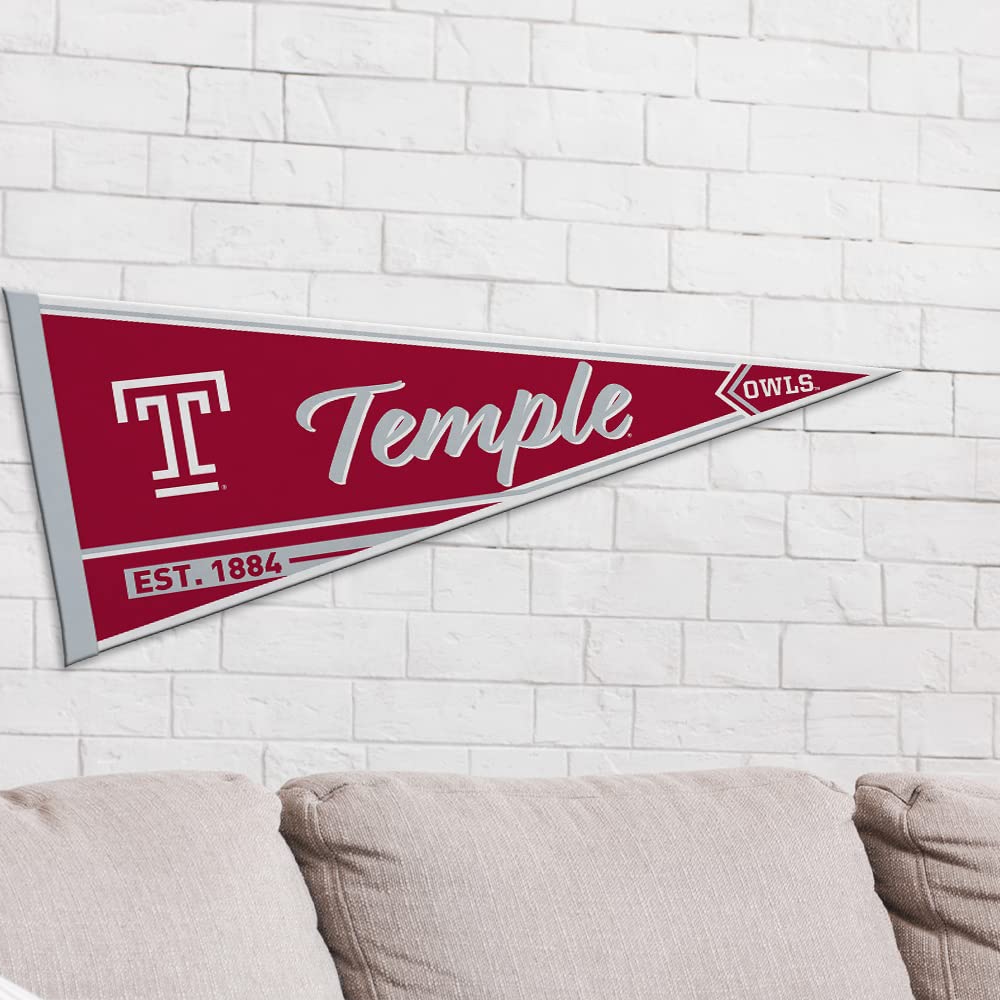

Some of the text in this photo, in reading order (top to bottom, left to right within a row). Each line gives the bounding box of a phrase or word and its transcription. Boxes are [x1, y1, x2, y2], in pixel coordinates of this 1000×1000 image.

[742, 373, 815, 400] OWLS
[295, 360, 634, 488] Temple
[133, 552, 282, 595] EST. 1884
